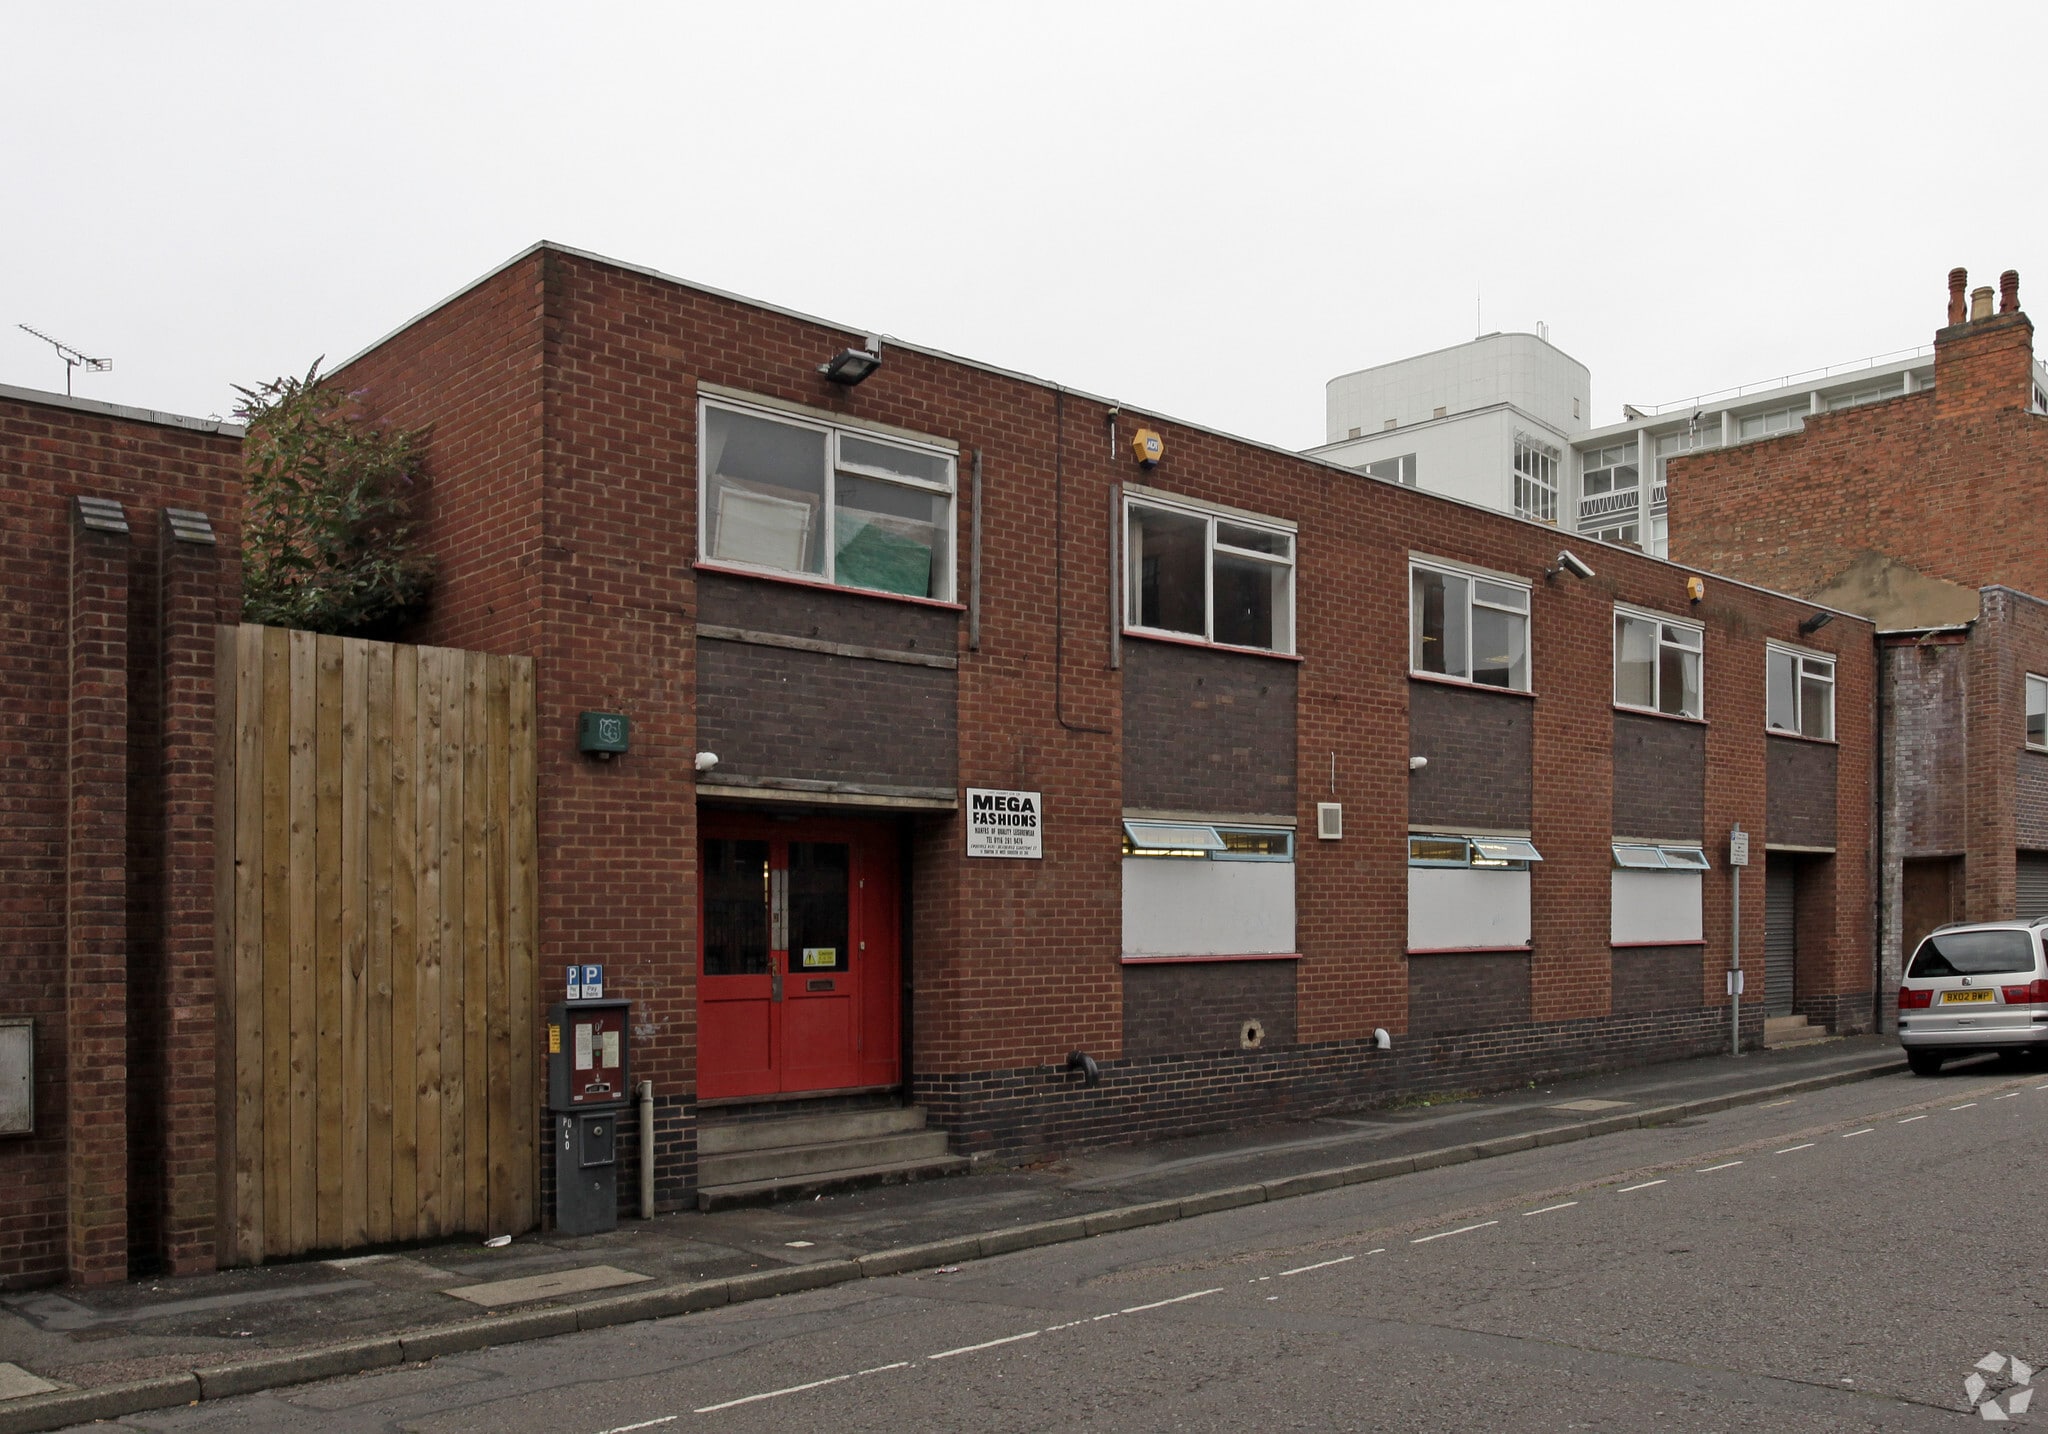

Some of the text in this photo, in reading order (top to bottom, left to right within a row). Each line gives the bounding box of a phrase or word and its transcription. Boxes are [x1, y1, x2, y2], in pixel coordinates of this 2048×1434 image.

[973, 794, 1035, 813] MEGA
[973, 812, 1037, 827] FASHIONS
[569, 967, 576, 984] P
[586, 967, 598, 984] P
[1947, 991, 1989, 1002] BX02 BWP
